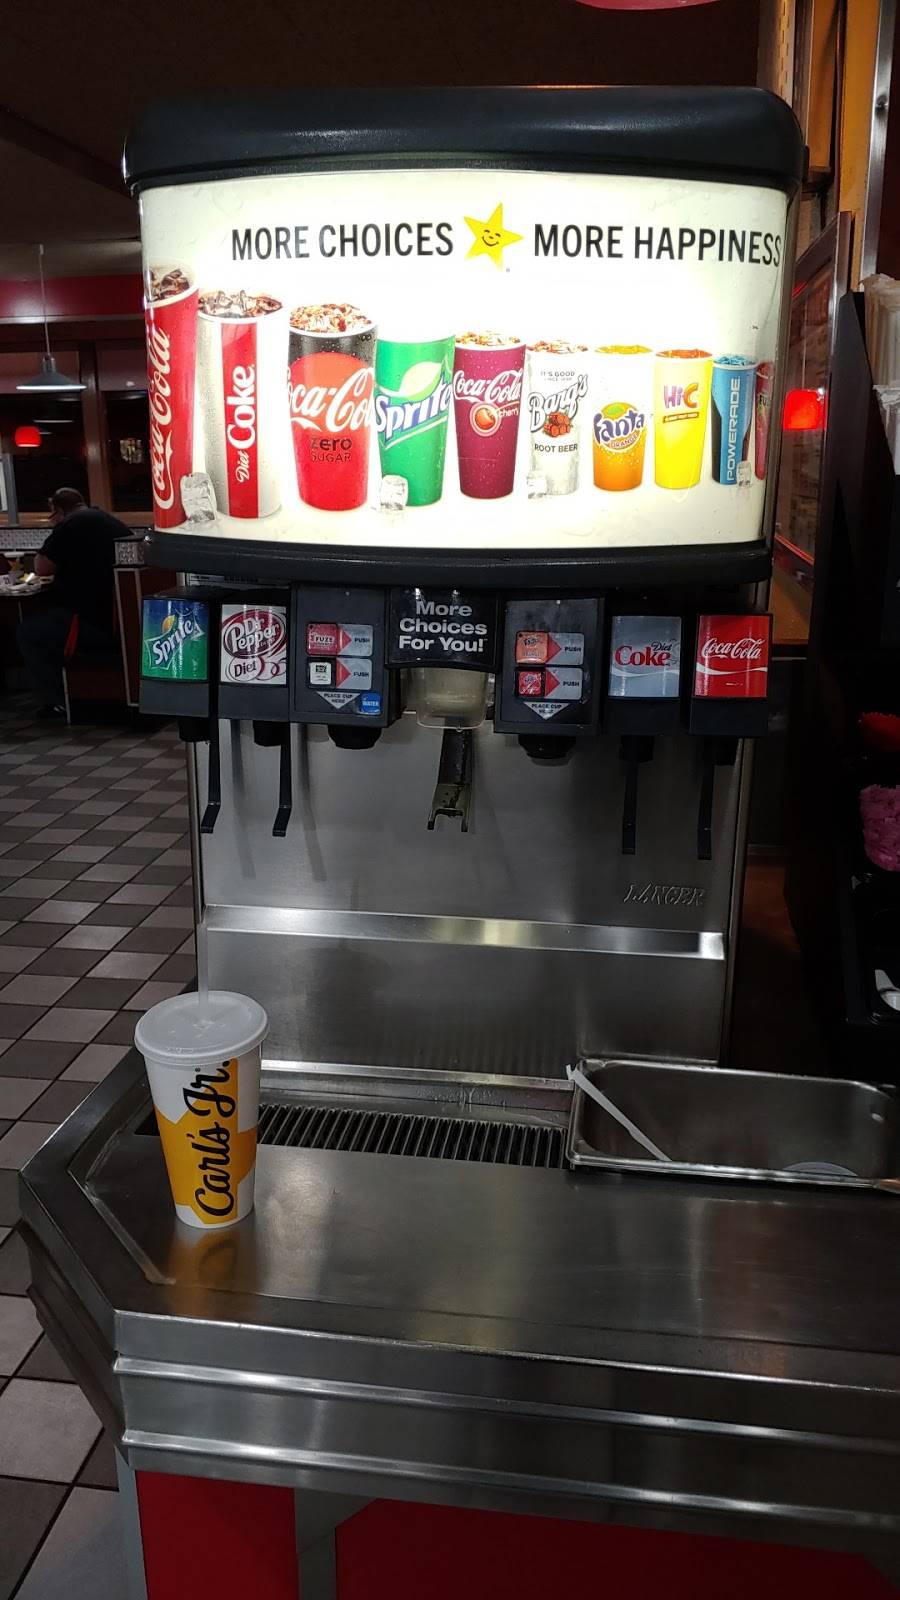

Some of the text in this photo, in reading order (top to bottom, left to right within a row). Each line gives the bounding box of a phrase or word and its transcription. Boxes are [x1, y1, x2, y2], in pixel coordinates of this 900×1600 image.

[232, 222, 782, 267] MORE CHOICES MORE HAPPINESS
[375, 378, 453, 440] Sprite
[528, 374, 588, 433] Barq's
[226, 366, 255, 483] Diet Coke
[727, 377, 741, 481] POWERADE
[534, 444, 577, 453] ROOT BEER
[416, 600, 473, 616] More
[230, 622, 280, 653] Pepper
[244, 618, 265, 635] Dr
[399, 618, 488, 635] Choices
[153, 619, 194, 665] Sprite
[399, 635, 484, 652] For You!
[651, 641, 672, 651] Diet
[701, 637, 765, 660] Coca-Cola
[614, 645, 671, 666] Coke
[234, 661, 257, 677] Diet
[183, 1060, 236, 1216] Carl's Jr.
